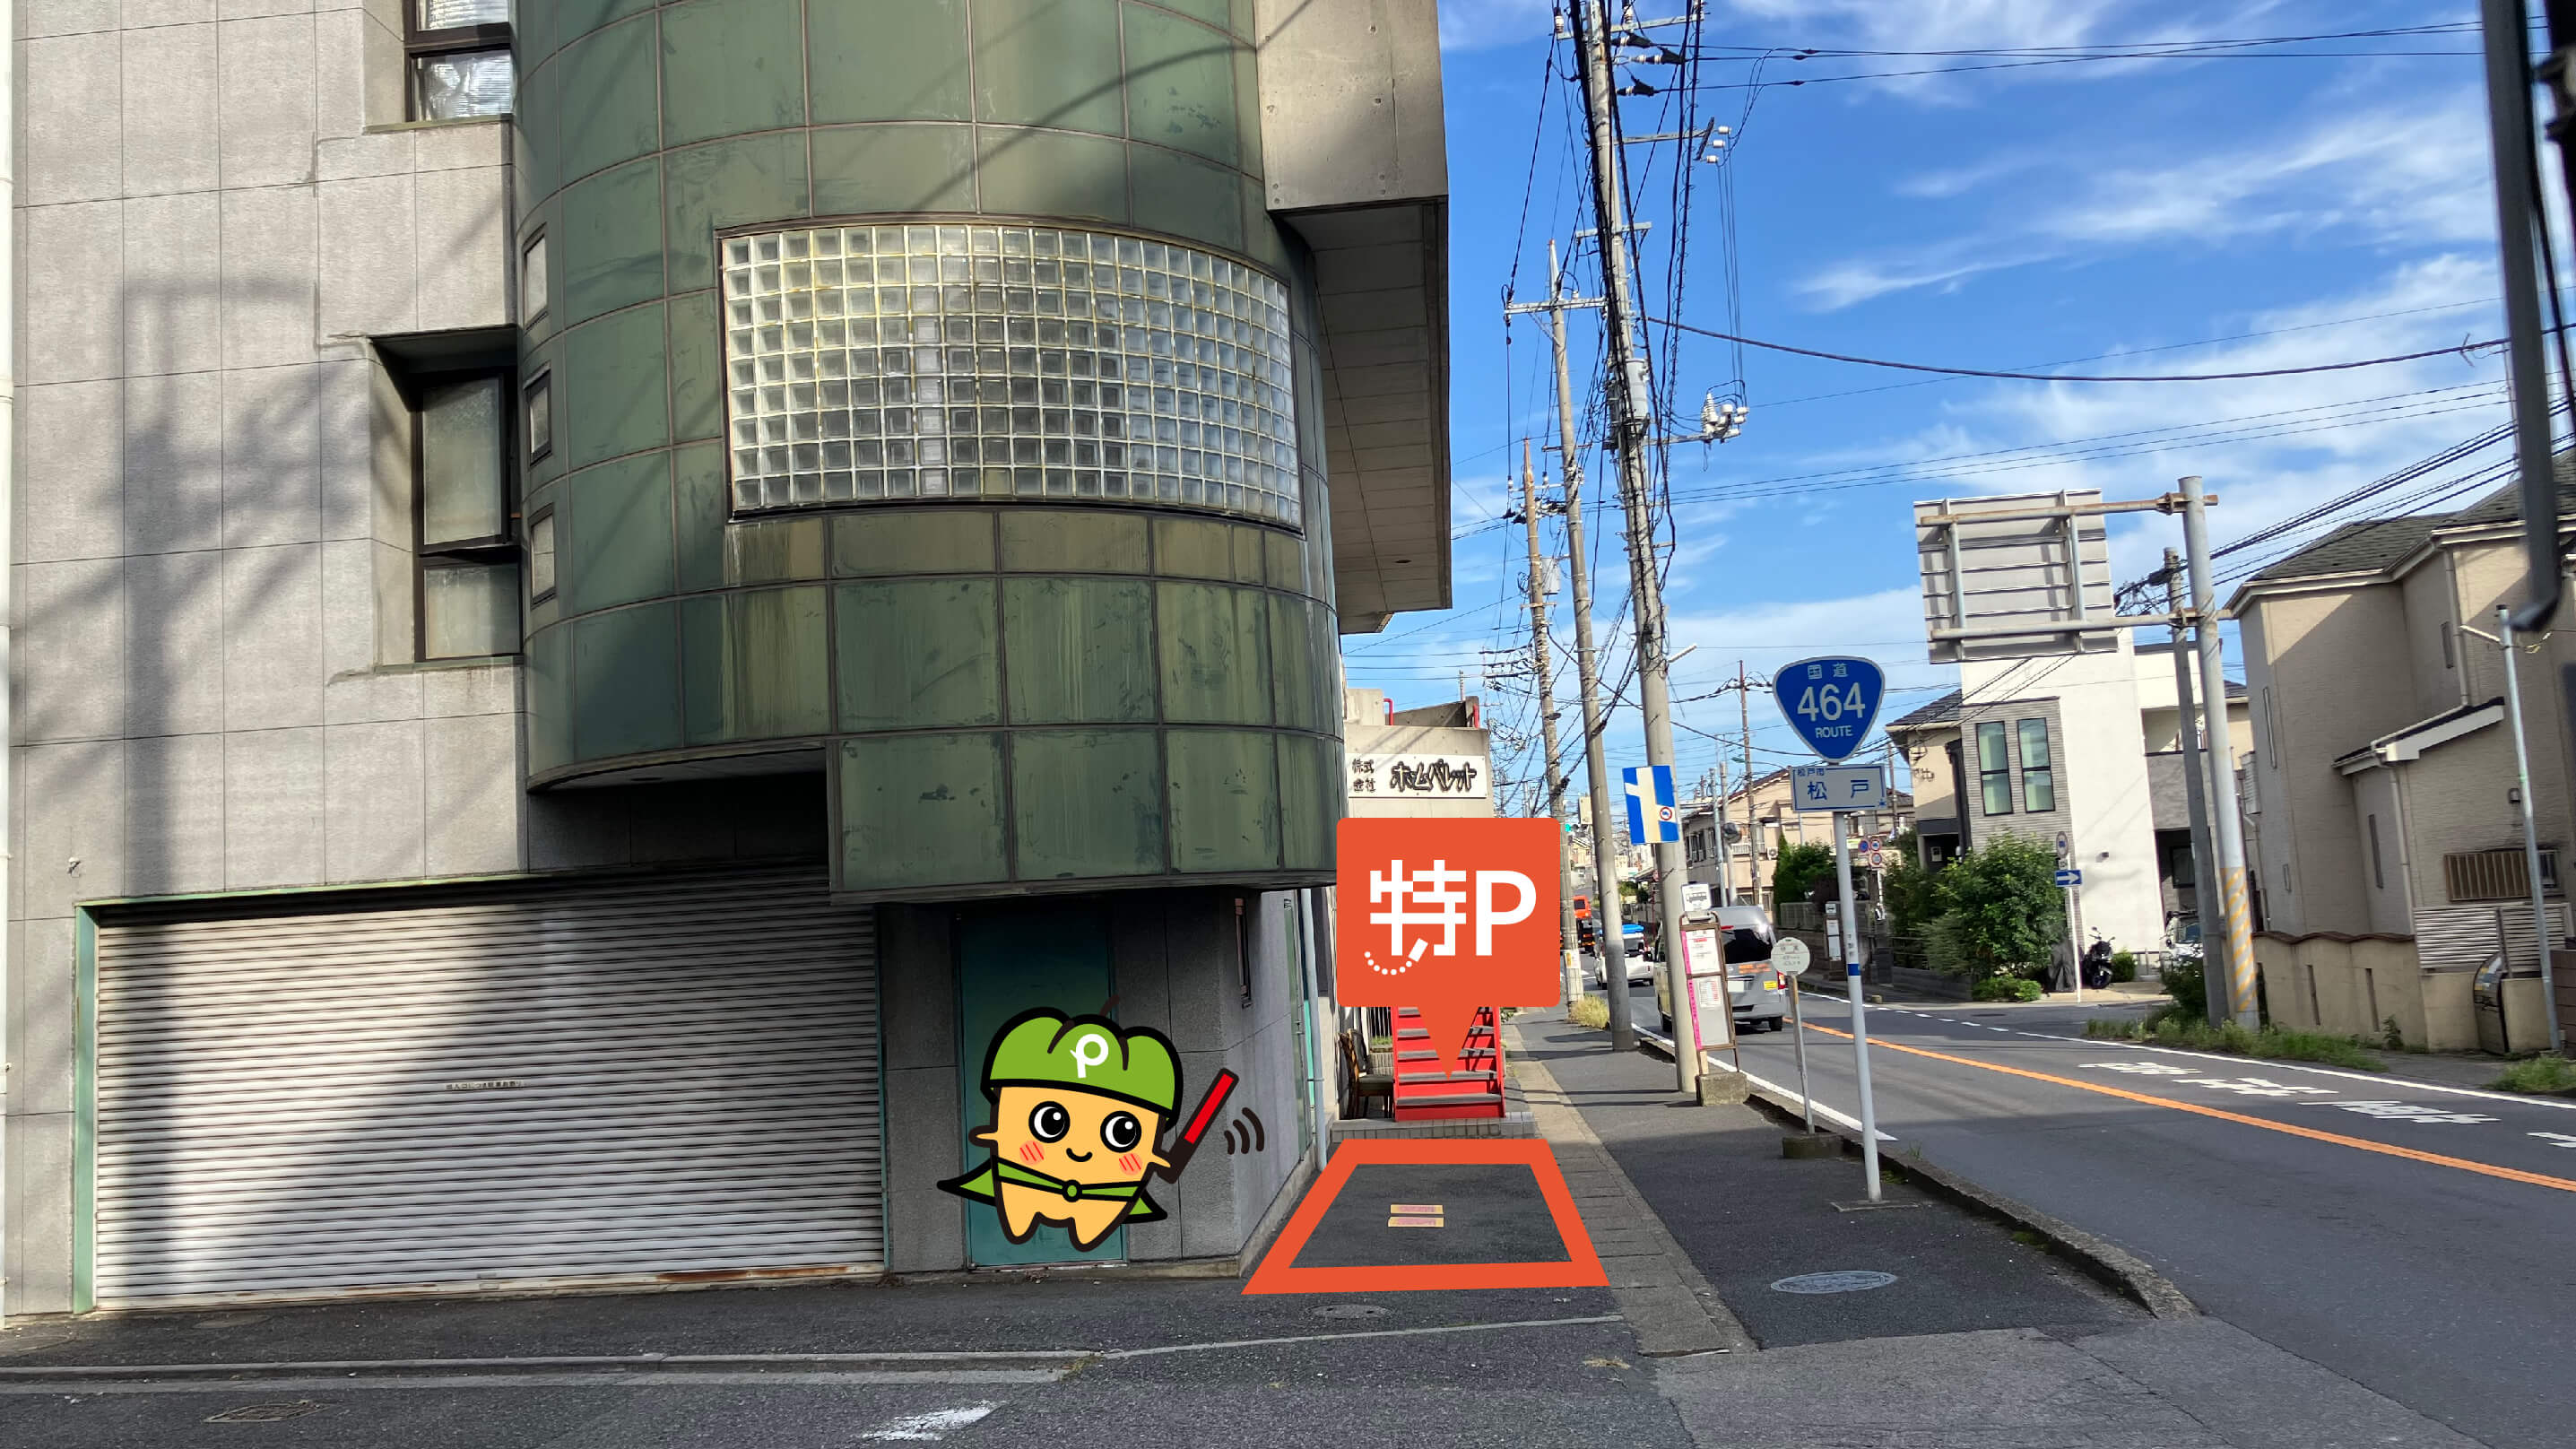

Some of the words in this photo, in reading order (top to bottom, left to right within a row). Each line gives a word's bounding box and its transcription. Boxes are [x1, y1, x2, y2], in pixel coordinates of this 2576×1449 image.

[1808, 664, 1849, 680] 国道
[1798, 682, 1866, 722] 464
[1816, 725, 1853, 738] ROUTE
[1352, 759, 1375, 774] 株式
[1797, 768, 1826, 777] 松戸市
[1808, 779, 1870, 801] 松戸
